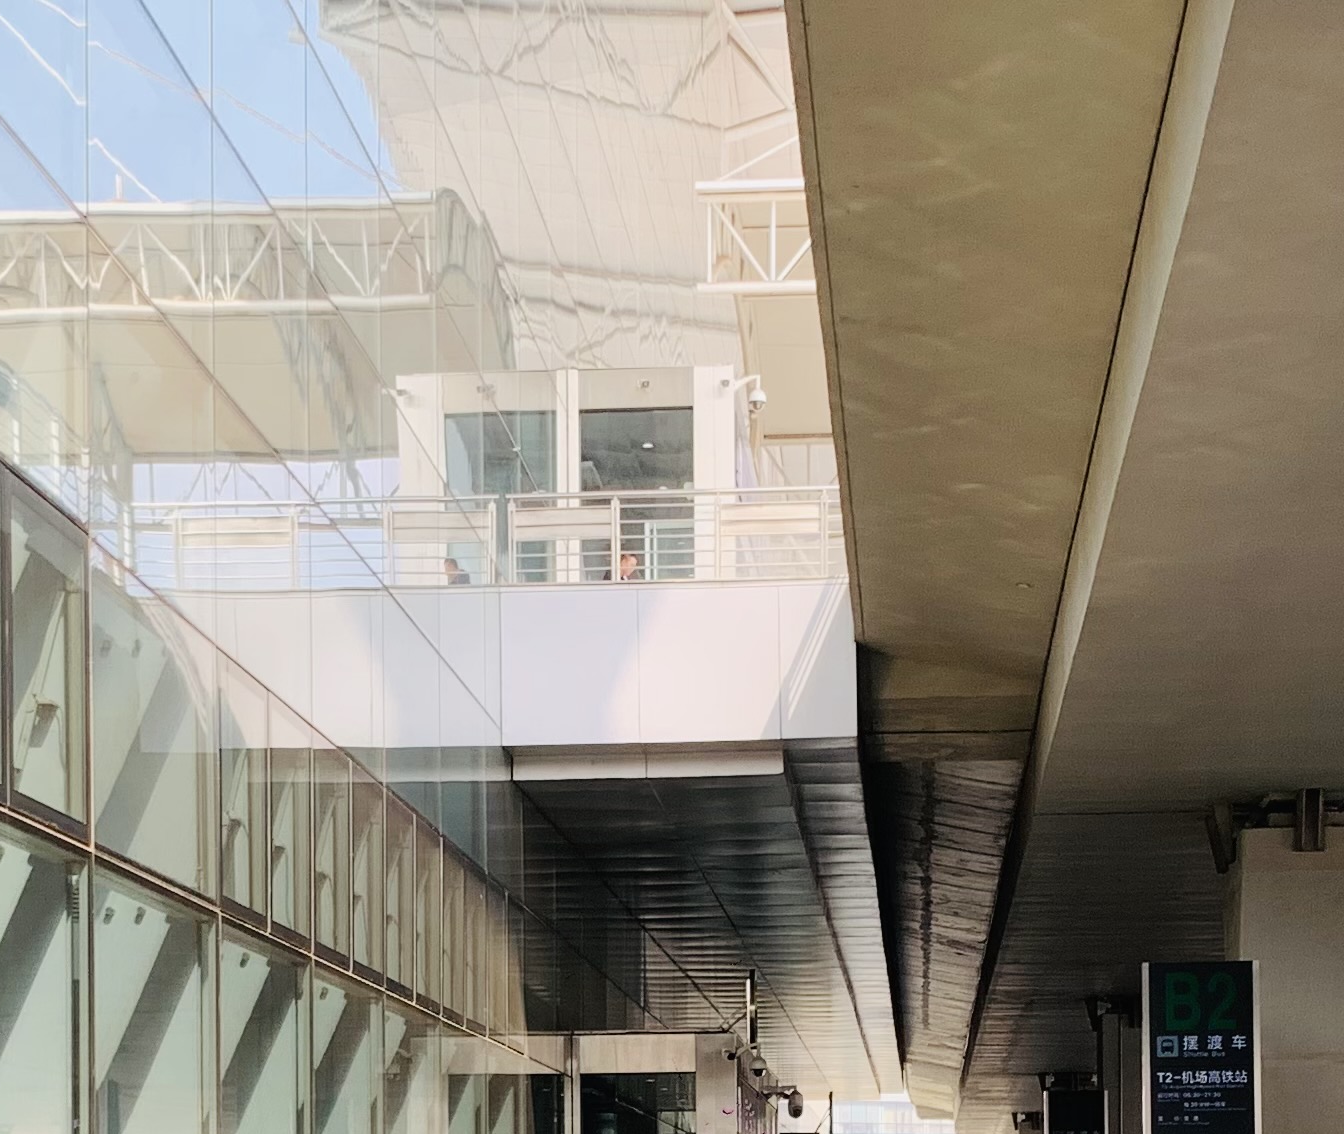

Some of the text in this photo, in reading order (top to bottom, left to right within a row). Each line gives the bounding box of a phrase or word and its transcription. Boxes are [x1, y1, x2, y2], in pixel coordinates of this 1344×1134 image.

[1166, 971, 1237, 1031] B2
[1183, 1035, 1247, 1050] 摆渡车
